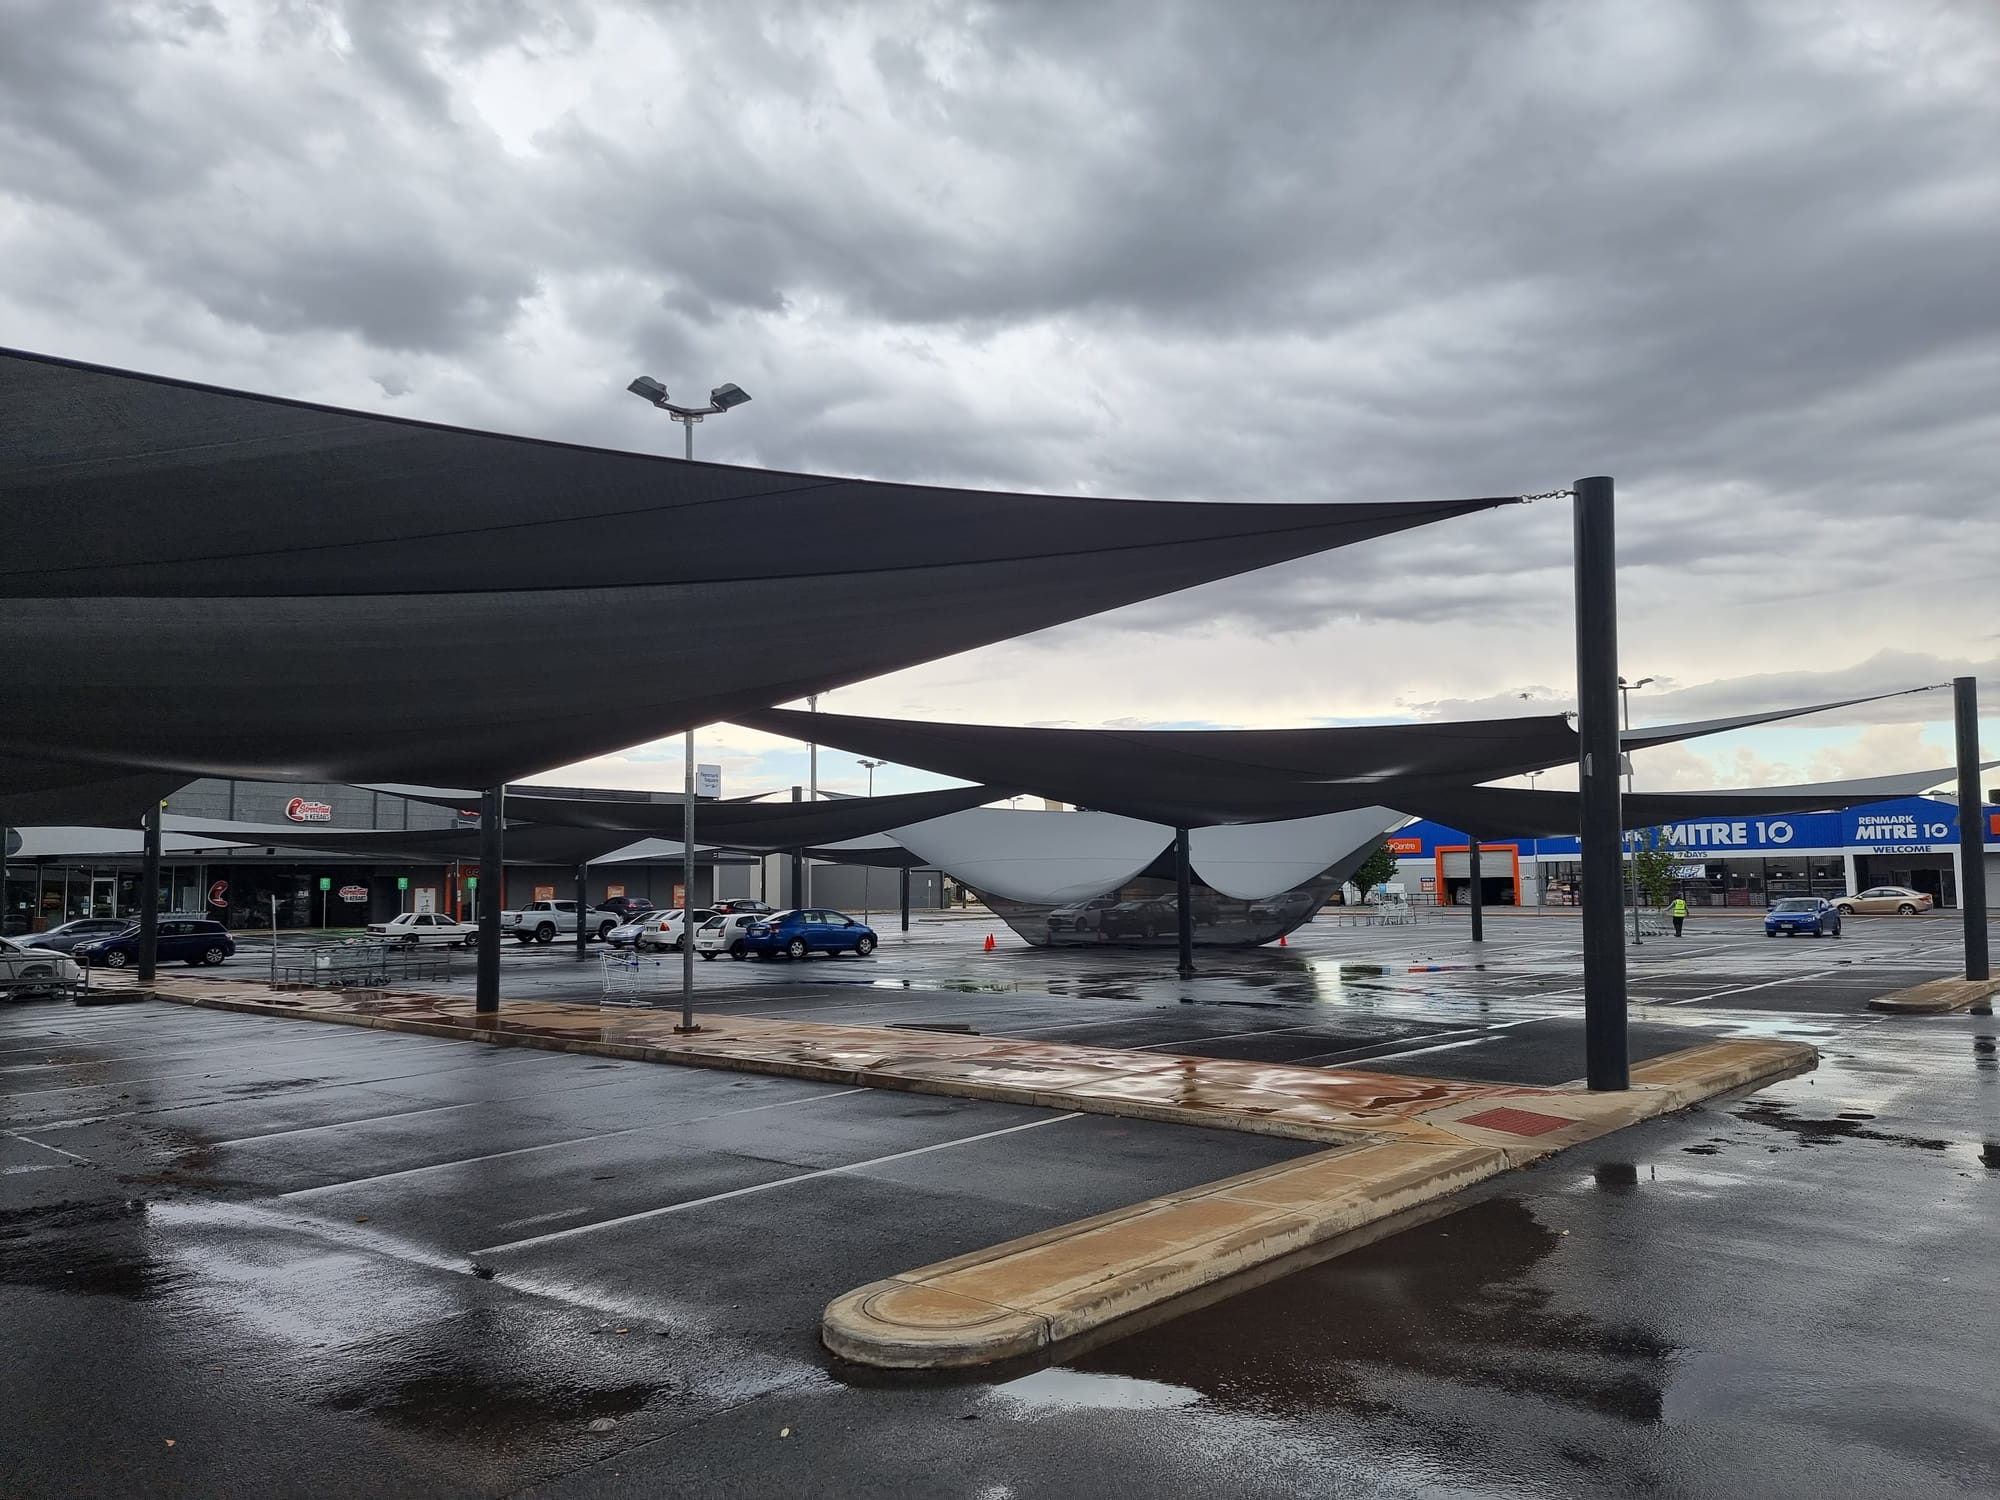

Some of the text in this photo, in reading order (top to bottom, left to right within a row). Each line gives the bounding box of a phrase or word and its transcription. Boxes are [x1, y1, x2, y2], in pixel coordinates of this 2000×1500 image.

[1858, 815, 1914, 825] RENMARK
[1659, 822, 1748, 846] MITRE
[1755, 821, 1794, 844] 10
[1855, 823, 1948, 840] MITRE 10
[1873, 845, 1932, 853] WELCOME
